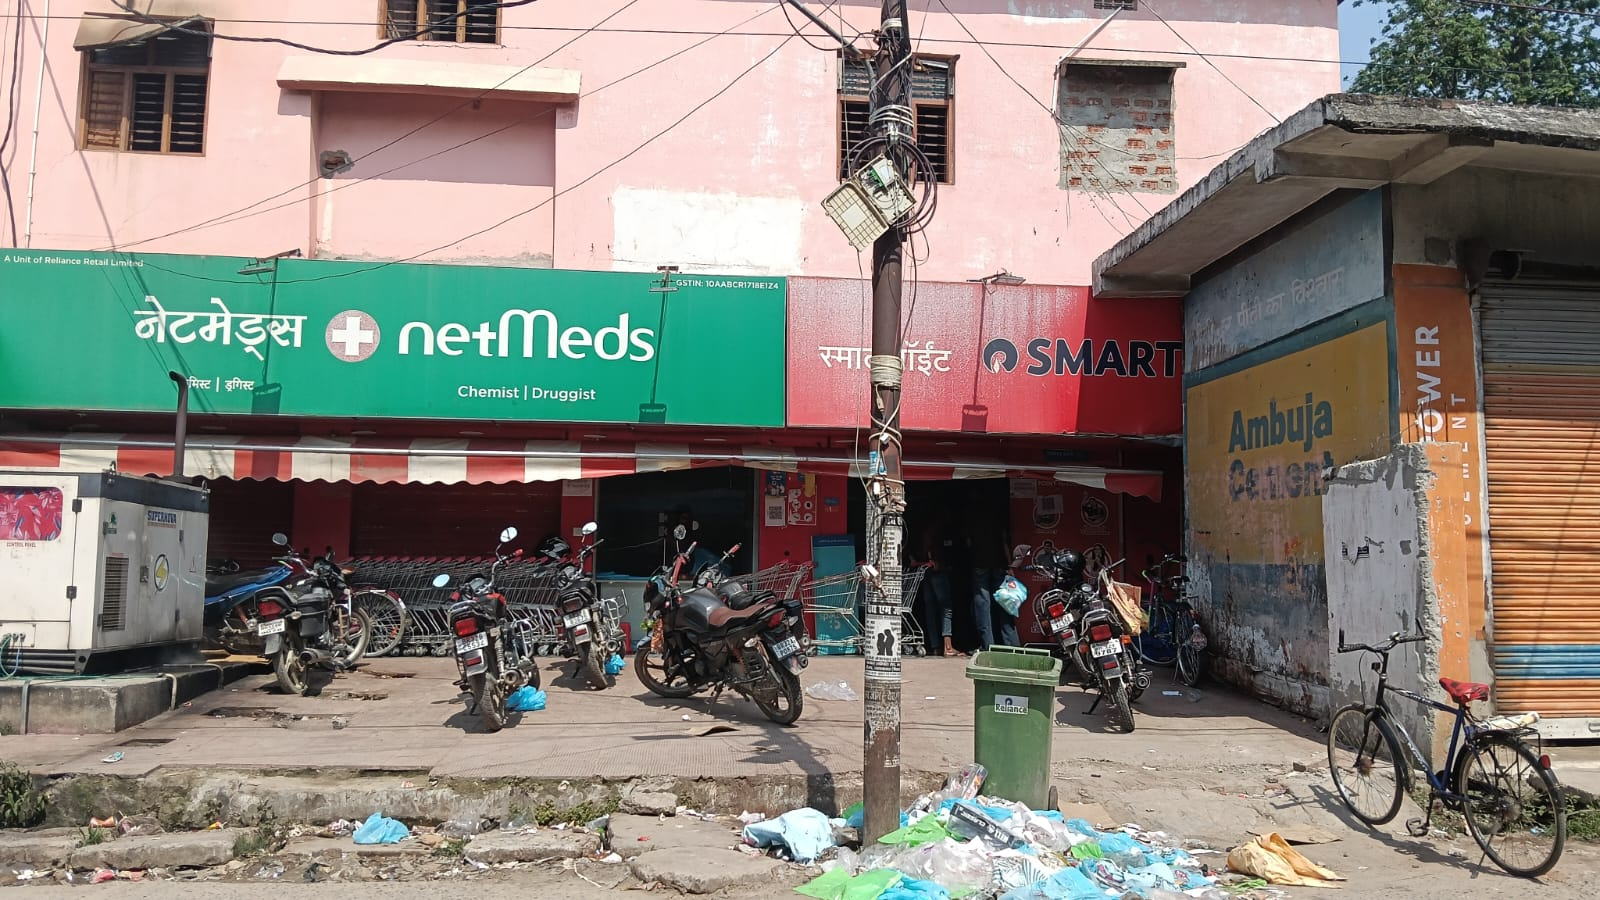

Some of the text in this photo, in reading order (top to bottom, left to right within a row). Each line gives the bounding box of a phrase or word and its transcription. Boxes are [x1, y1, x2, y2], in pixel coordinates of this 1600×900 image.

[13, 255, 31, 263] Unit
[33, 256, 43, 264] of
[45, 257, 81, 265] Reliance
[84, 258, 109, 266] Retail
[111, 259, 144, 267] Limited
[676, 279, 704, 287] GSTIN:
[133, 295, 308, 361] नेटमेड्स
[398, 308, 655, 362] netMeds
[1026, 337, 1183, 378] SMART
[457, 384, 596, 403] Chemist Druggist
[1415, 326, 1444, 442] OWER
[1228, 391, 1333, 453] Ambuja
[996, 703, 1027, 714] Reliance
